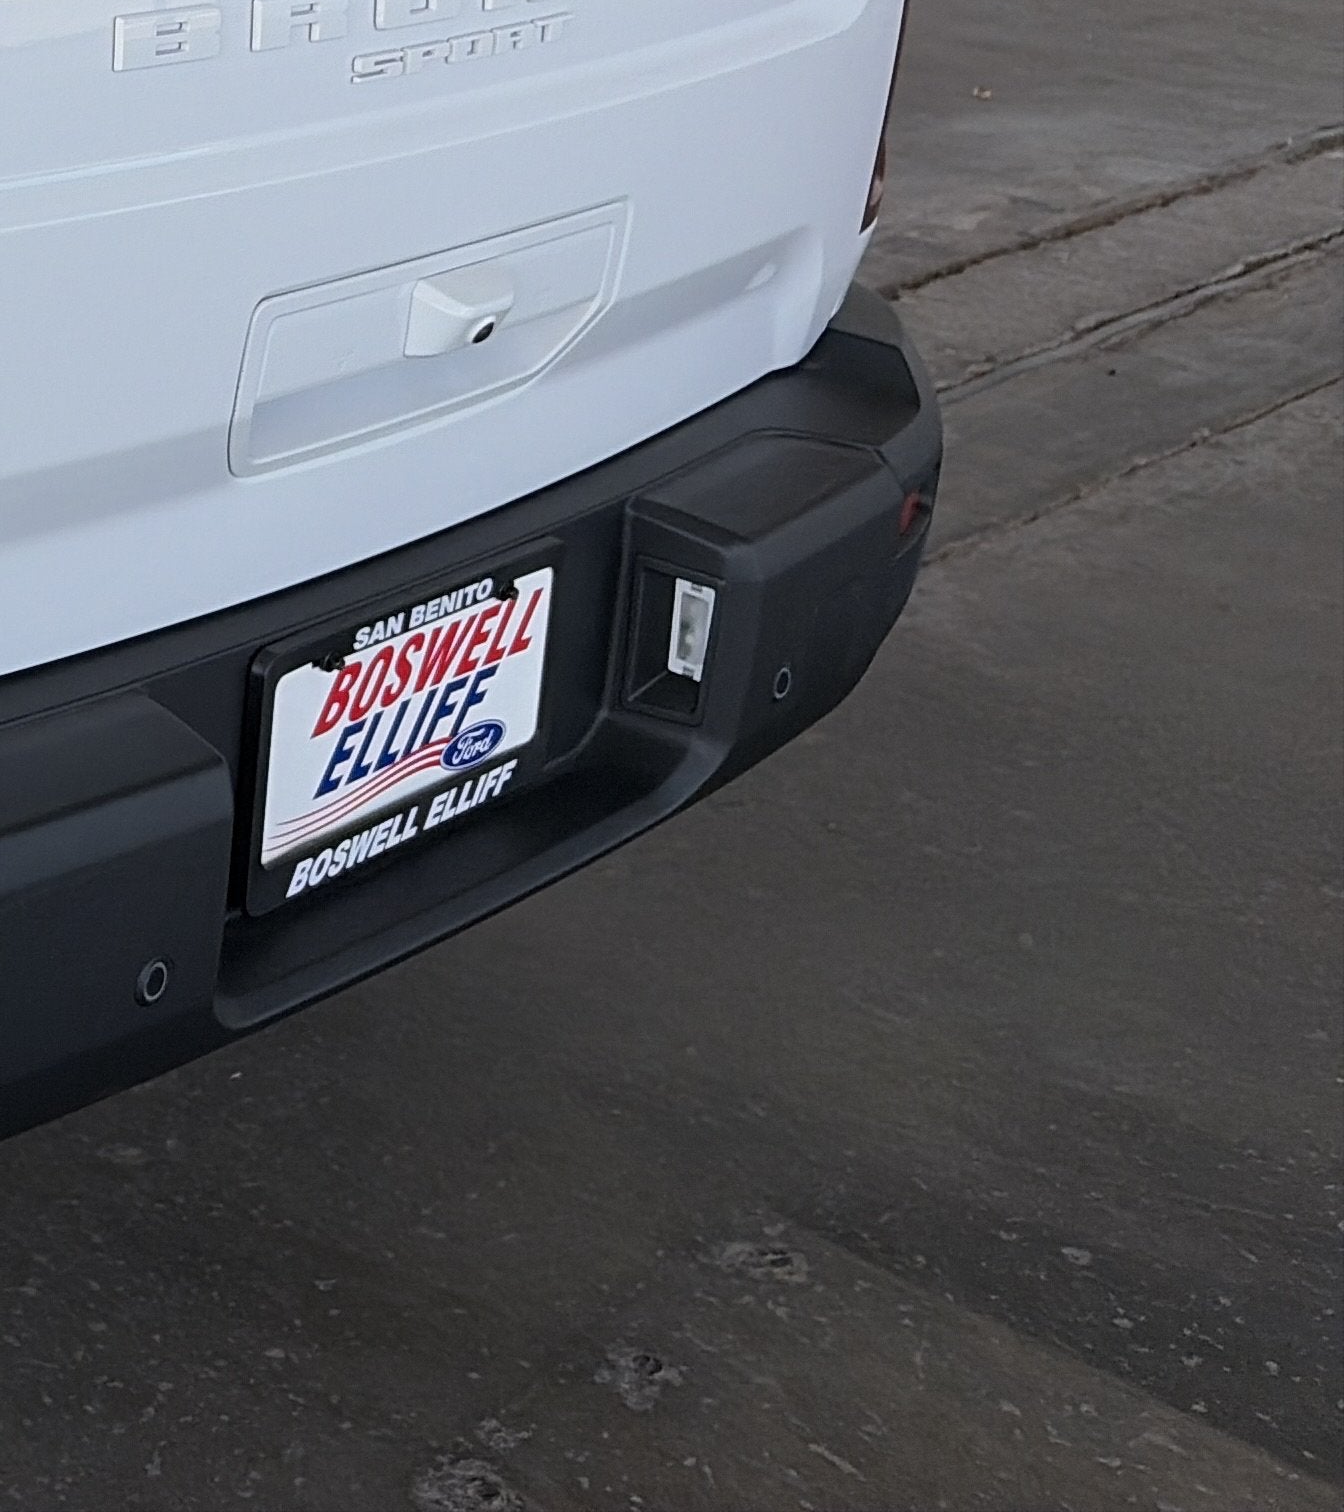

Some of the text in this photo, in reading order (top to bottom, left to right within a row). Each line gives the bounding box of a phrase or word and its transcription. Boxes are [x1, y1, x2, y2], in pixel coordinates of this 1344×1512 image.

[351, 10, 574, 84] SPORT
[310, 587, 544, 740] BOSWELL
[353, 577, 493, 651] SAN BENITO
[313, 664, 499, 800] ELLIFF
[452, 728, 494, 765] Ford
[285, 758, 518, 899] BOSWELL ELLIFF
